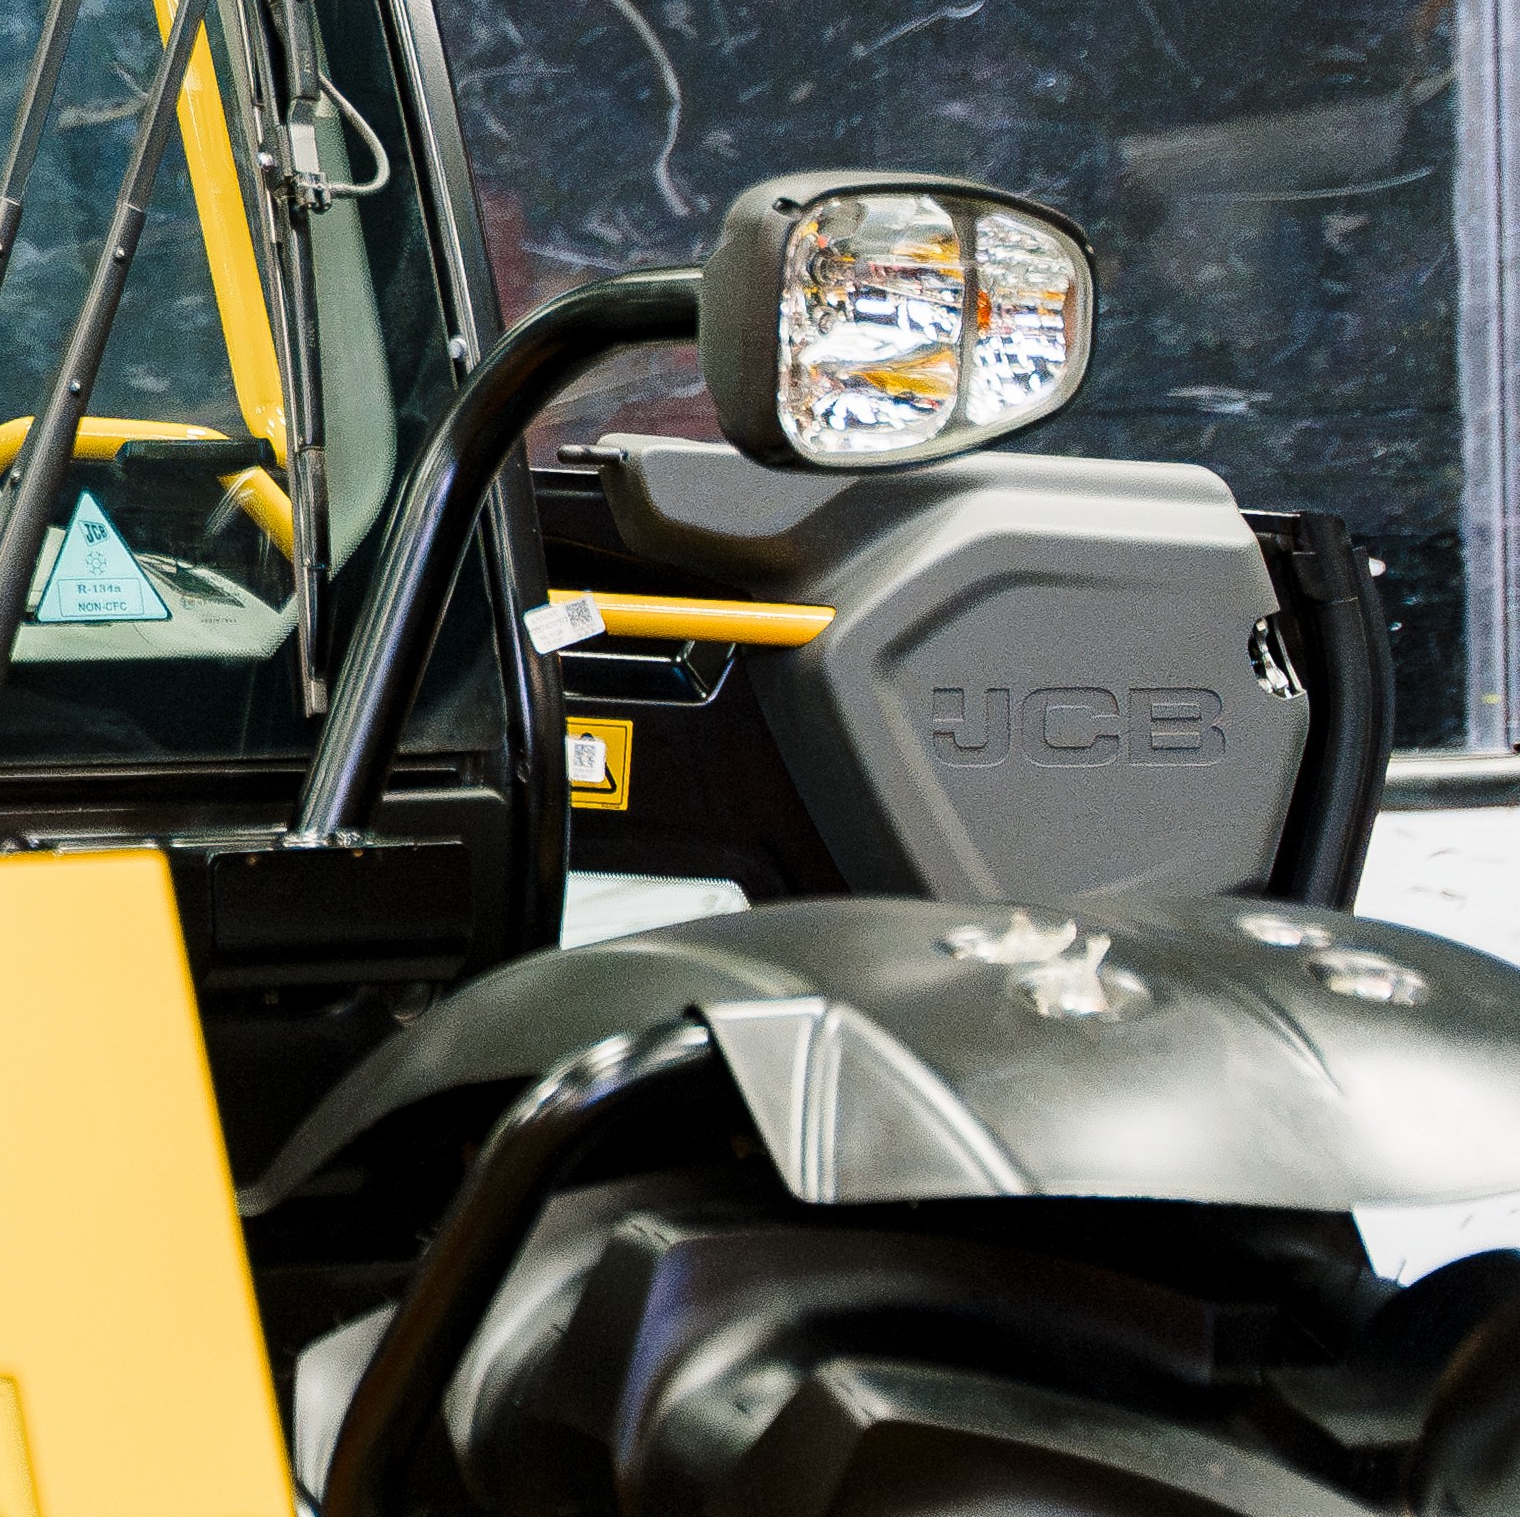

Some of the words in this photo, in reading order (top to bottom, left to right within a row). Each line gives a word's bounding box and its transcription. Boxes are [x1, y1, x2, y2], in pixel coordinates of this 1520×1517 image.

[84, 523, 108, 544] JCB
[77, 584, 122, 594] R-134a
[78, 601, 127, 612] NON-CFC
[930, 685, 1226, 769] JCB
